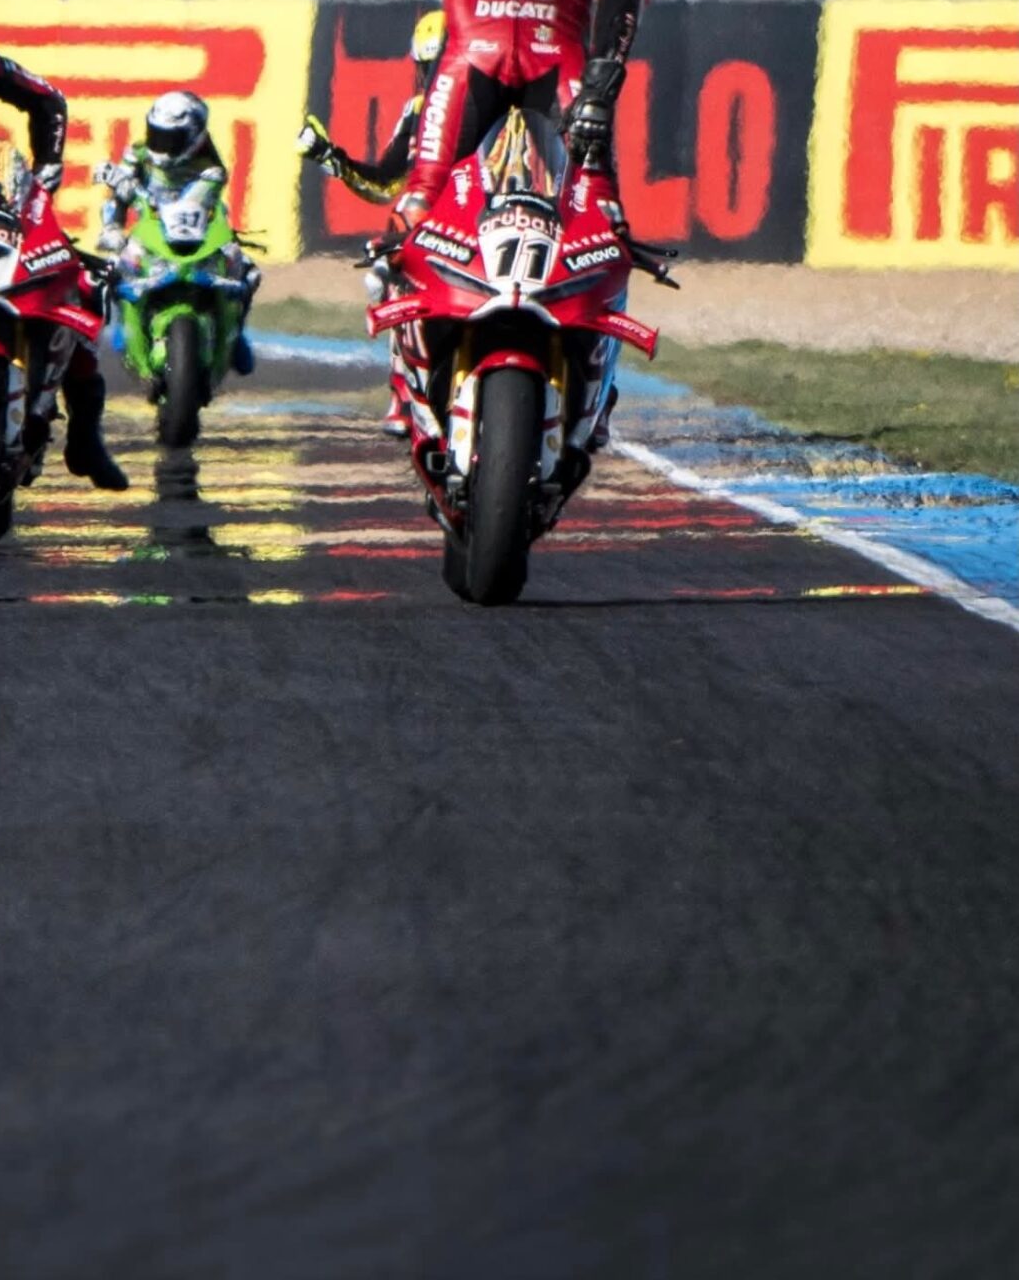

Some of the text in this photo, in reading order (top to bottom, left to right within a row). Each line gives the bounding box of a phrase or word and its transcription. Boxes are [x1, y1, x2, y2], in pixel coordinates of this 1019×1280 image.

[475, 0, 557, 20] DUCATI
[417, 74, 455, 162] DUCATI
[422, 220, 478, 248] ALTEN
[478, 205, 565, 243] aruba.it
[415, 230, 472, 262] Lenovo
[562, 232, 615, 253] ALTEN
[25, 248, 72, 273] Lenovo
[495, 235, 552, 282] 11
[566, 245, 621, 272] Lenovo
